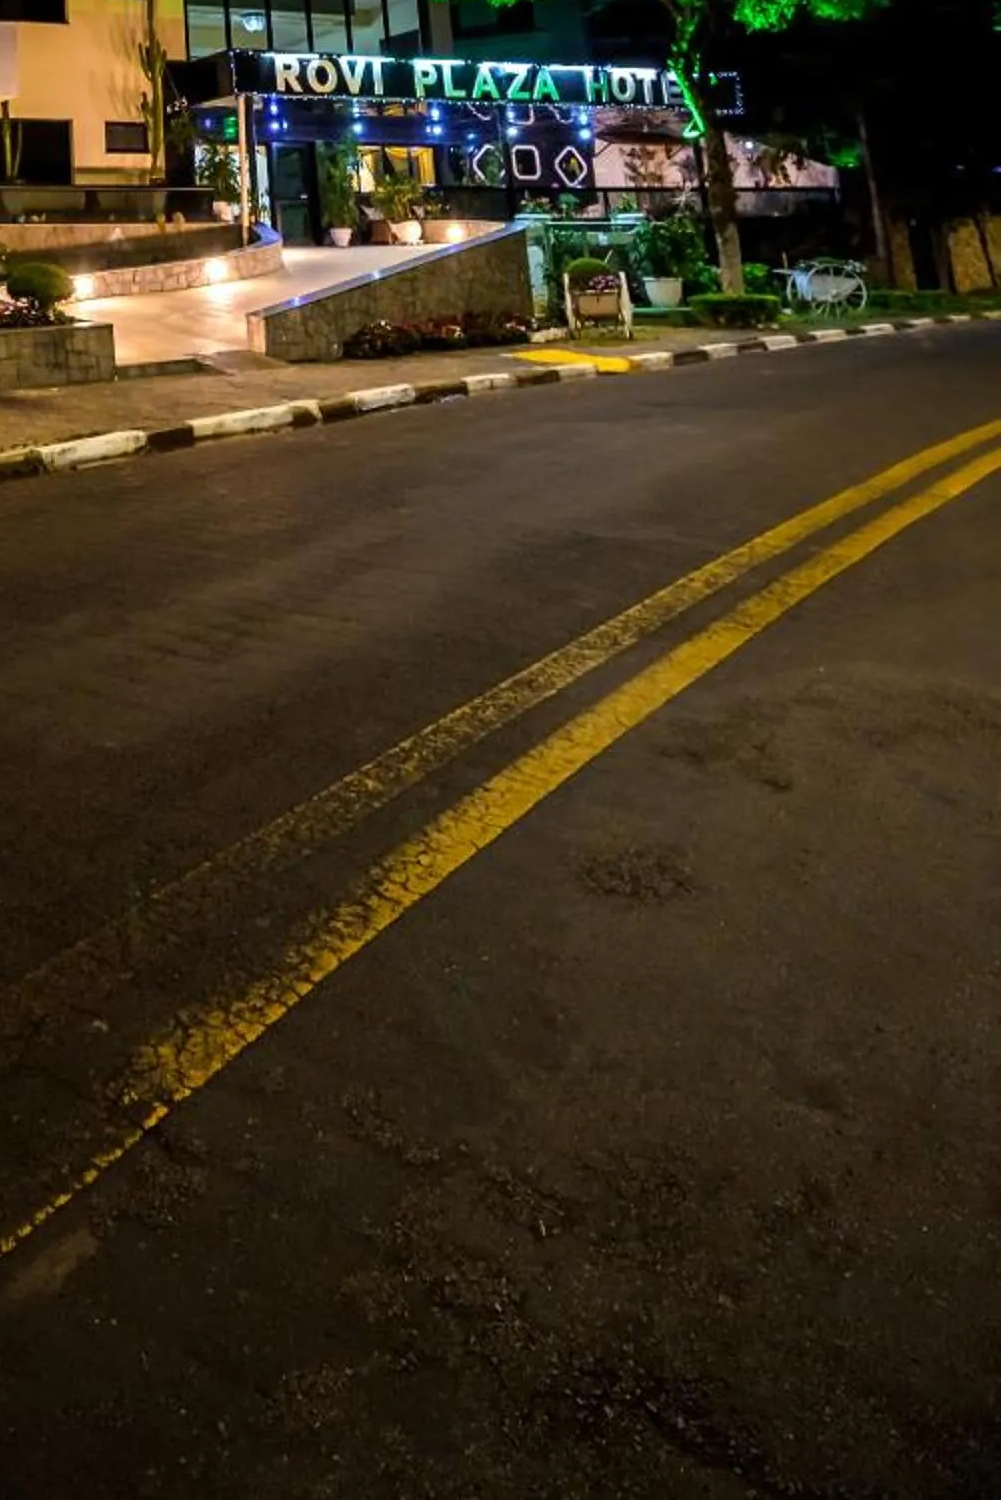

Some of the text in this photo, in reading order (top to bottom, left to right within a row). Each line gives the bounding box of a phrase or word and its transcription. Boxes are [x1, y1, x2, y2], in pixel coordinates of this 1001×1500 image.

[274, 55, 689, 106] ROVI PLAZA HOTE
